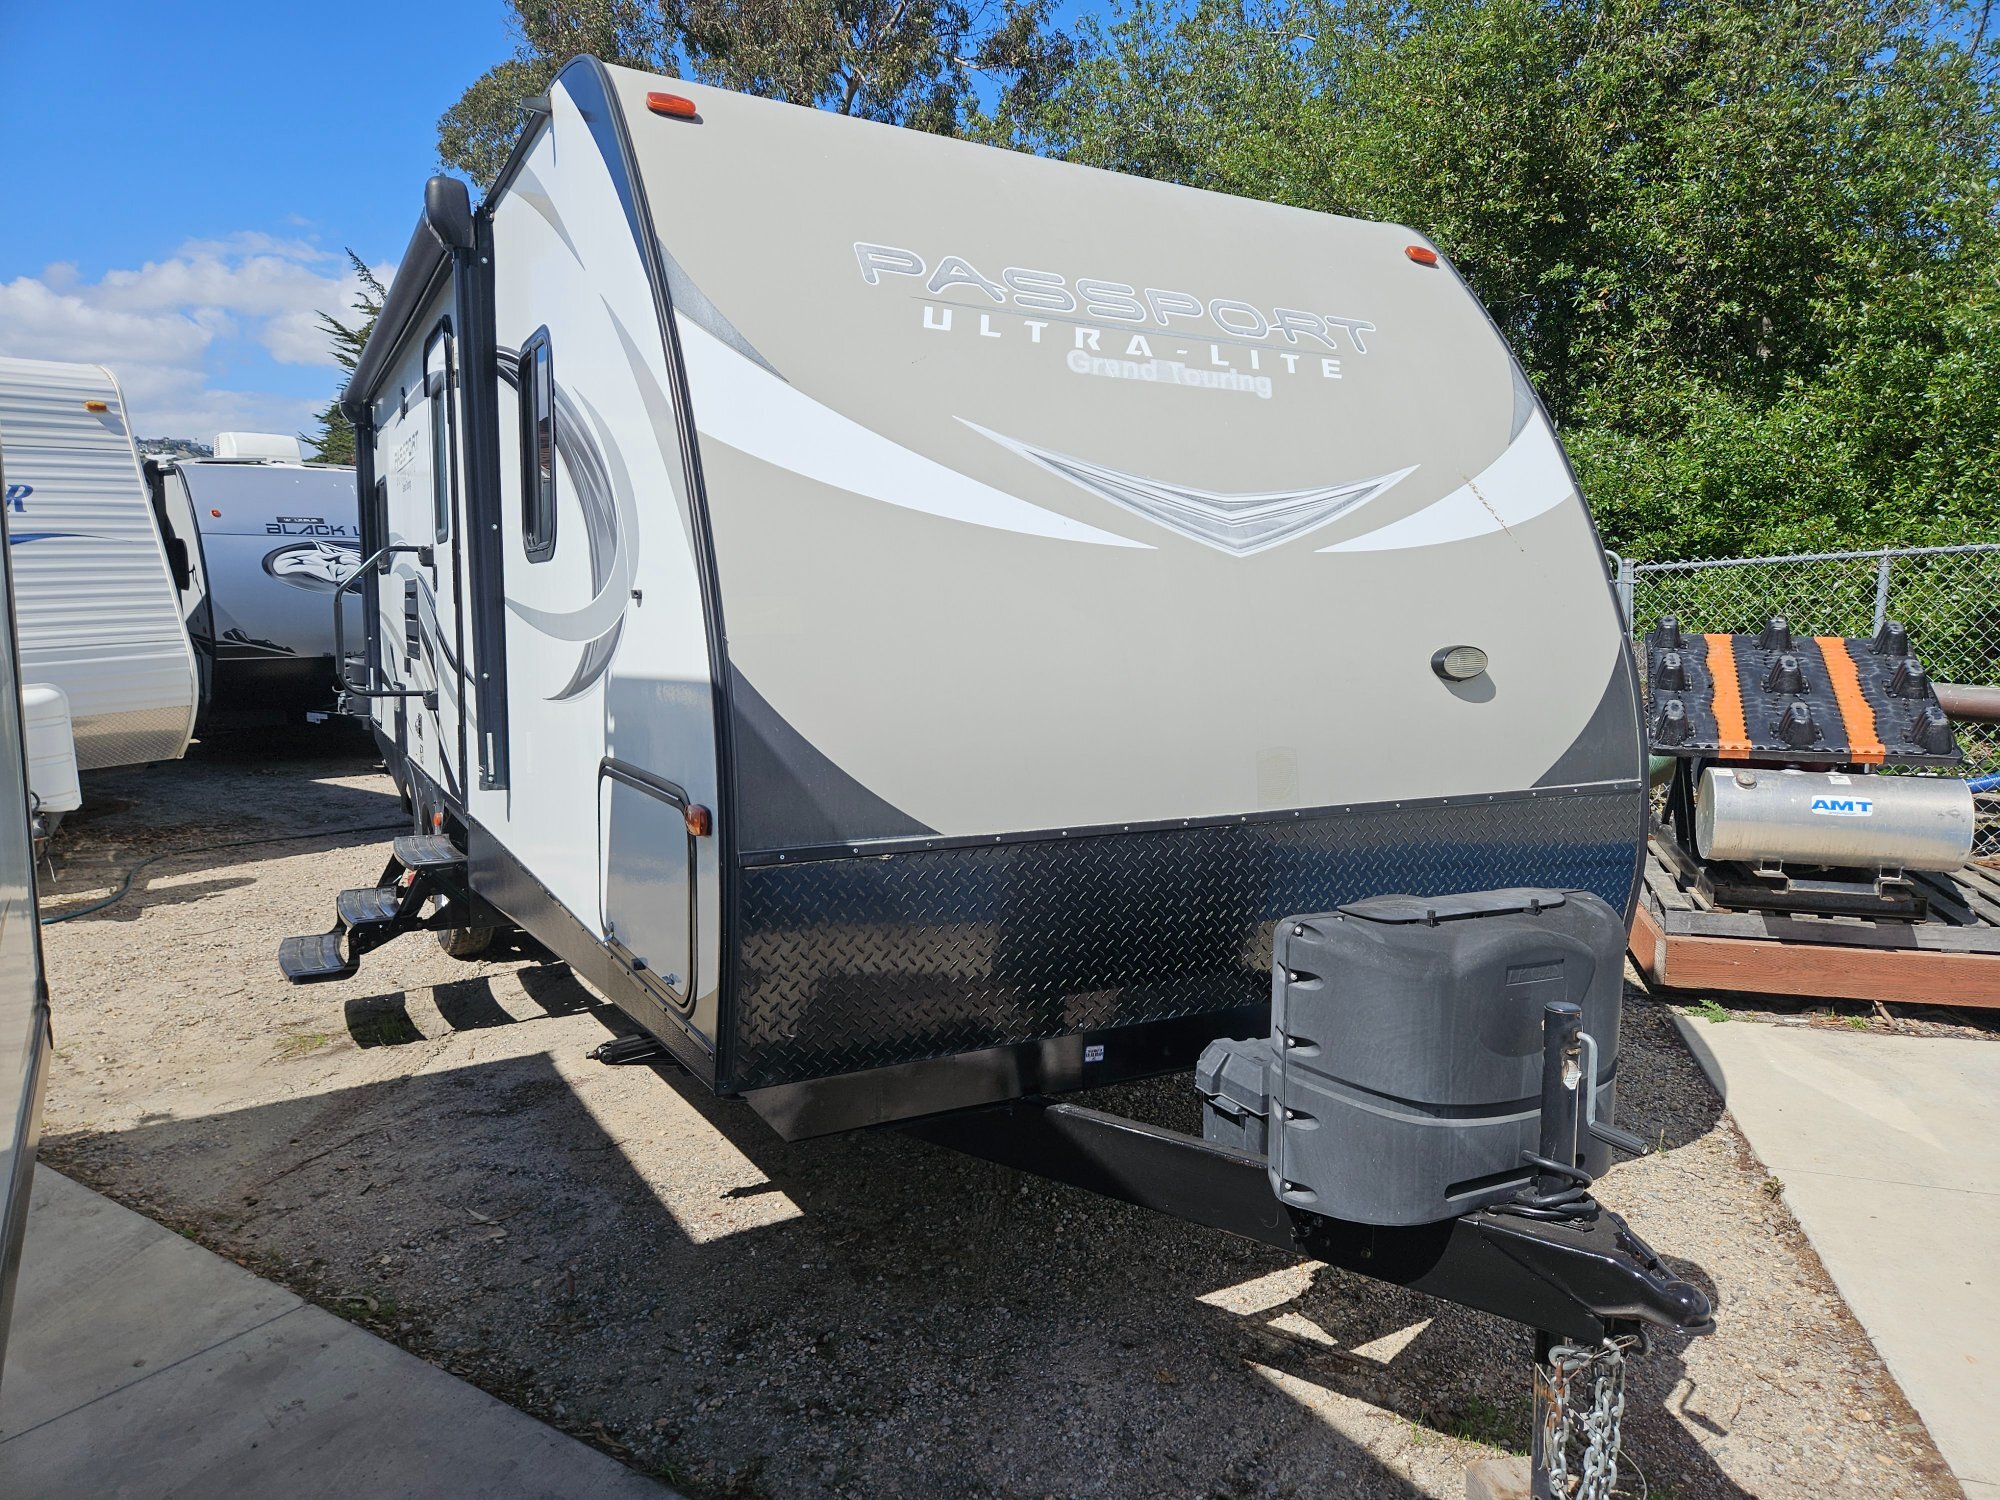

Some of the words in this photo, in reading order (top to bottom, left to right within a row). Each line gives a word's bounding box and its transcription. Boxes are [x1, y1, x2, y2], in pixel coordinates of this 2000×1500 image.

[853, 241, 1377, 355] PASSPORT
[922, 305, 1344, 380] ULTRA-LITE
[1066, 349, 1157, 383] Grand
[1170, 361, 1273, 400] Touring
[265, 523, 345, 536] BLACK
[1812, 800, 1873, 812] AMT
